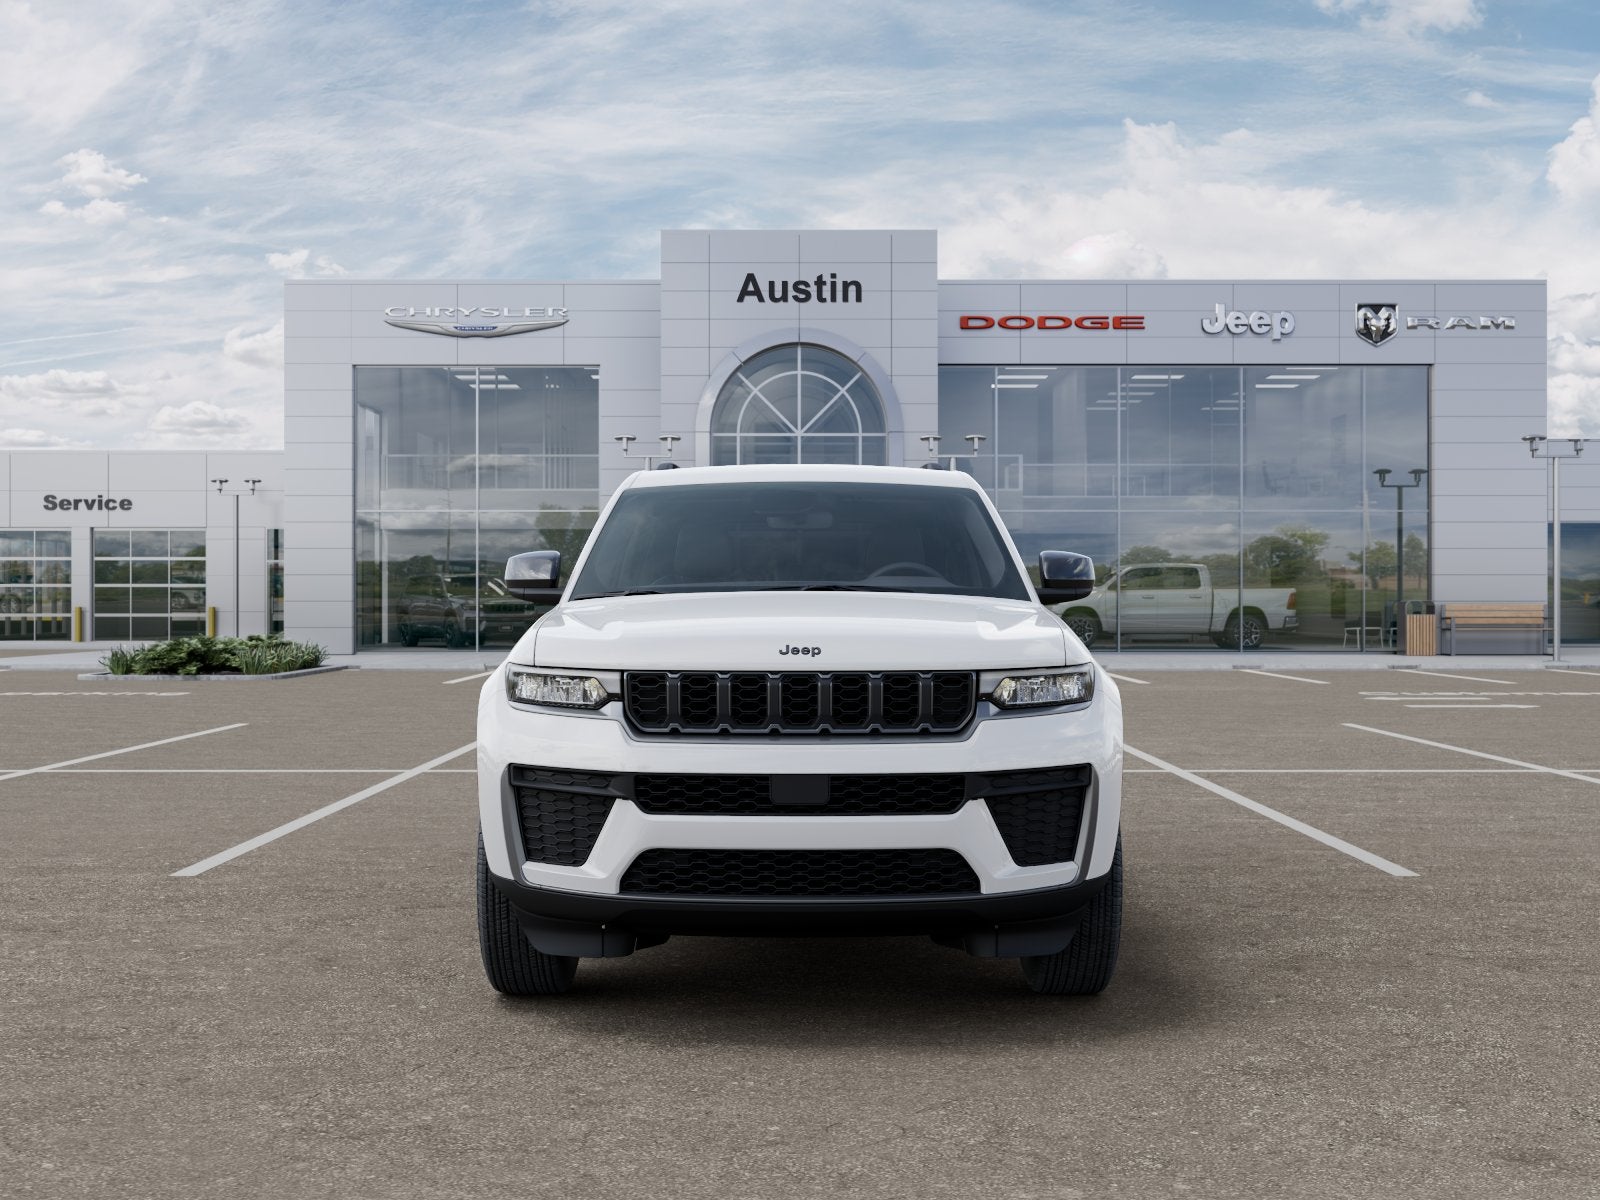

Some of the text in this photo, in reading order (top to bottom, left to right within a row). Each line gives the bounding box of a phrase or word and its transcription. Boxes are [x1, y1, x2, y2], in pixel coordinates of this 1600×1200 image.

[736, 272, 863, 303] Austin
[384, 306, 569, 317] CHRYSLER
[959, 315, 1146, 330] DODGE
[1201, 303, 1295, 341] Jeep
[1406, 316, 1516, 330] RAM
[43, 494, 133, 511] Service
[779, 644, 822, 658] Jeep
